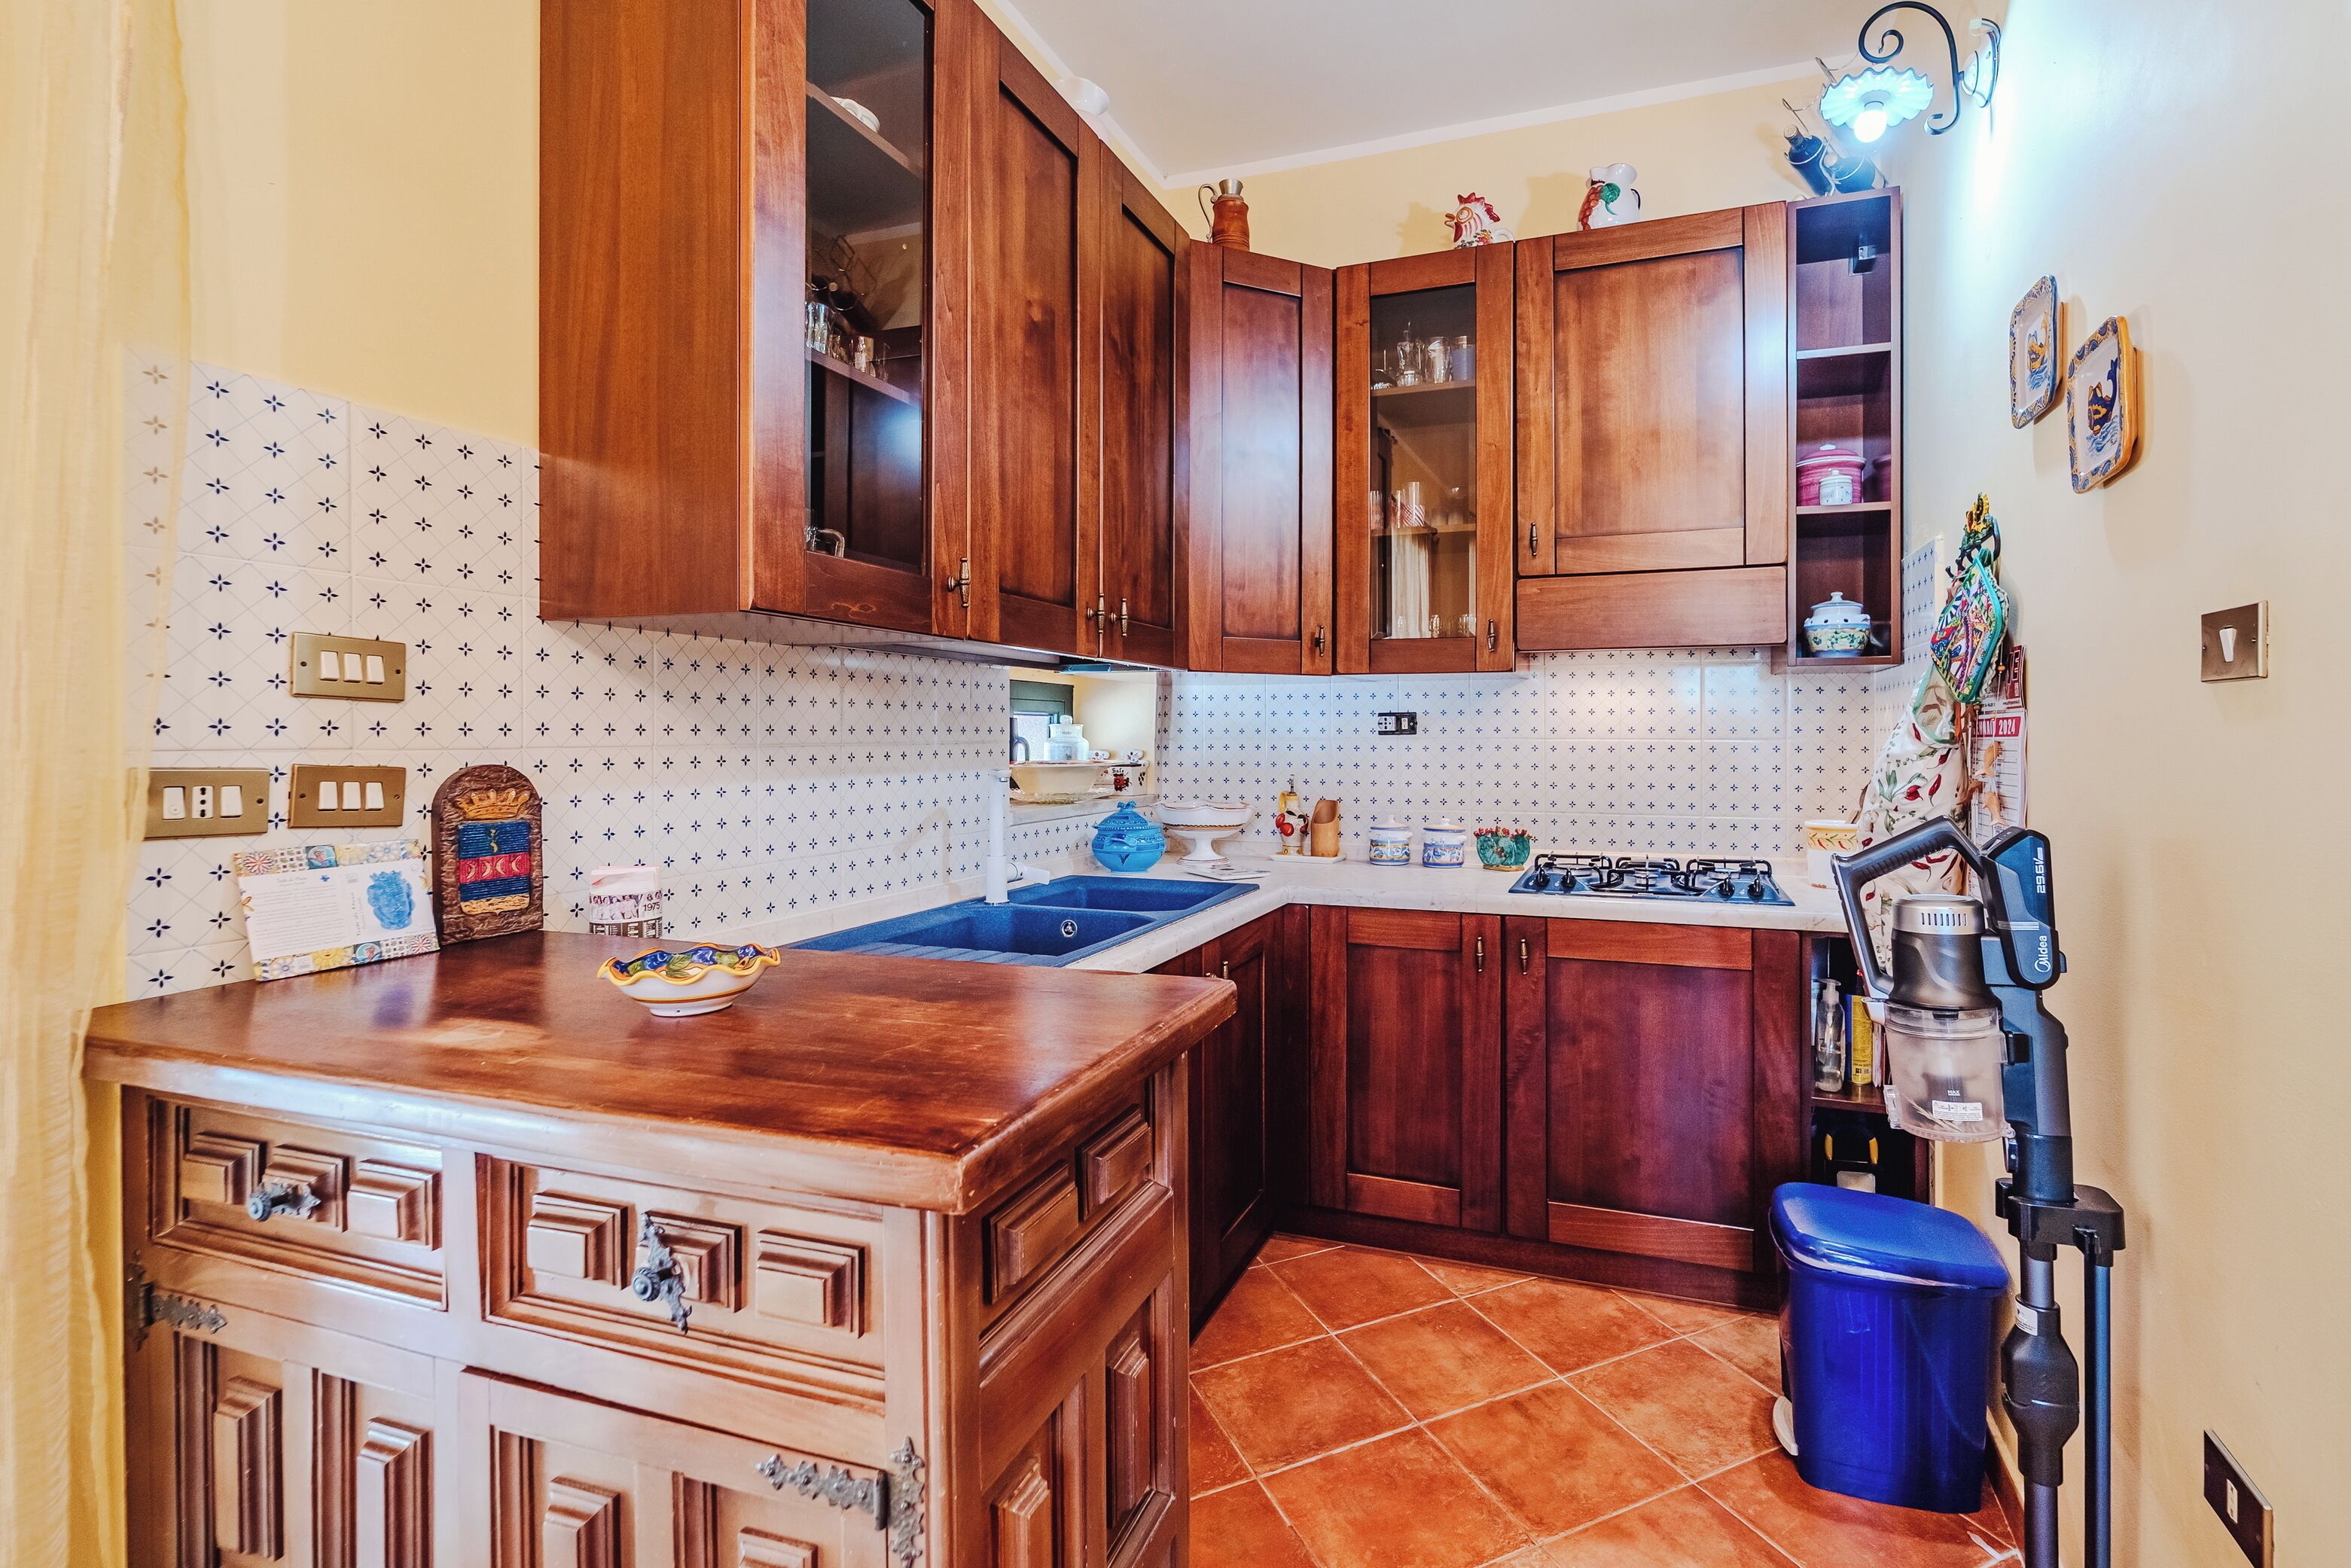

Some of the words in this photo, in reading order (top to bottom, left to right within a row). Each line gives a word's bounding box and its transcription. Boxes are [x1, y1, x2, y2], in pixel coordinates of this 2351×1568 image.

[1999, 718, 2016, 735] 2024
[643, 901, 660, 912] 1975
[2034, 935, 2051, 973] Midea
